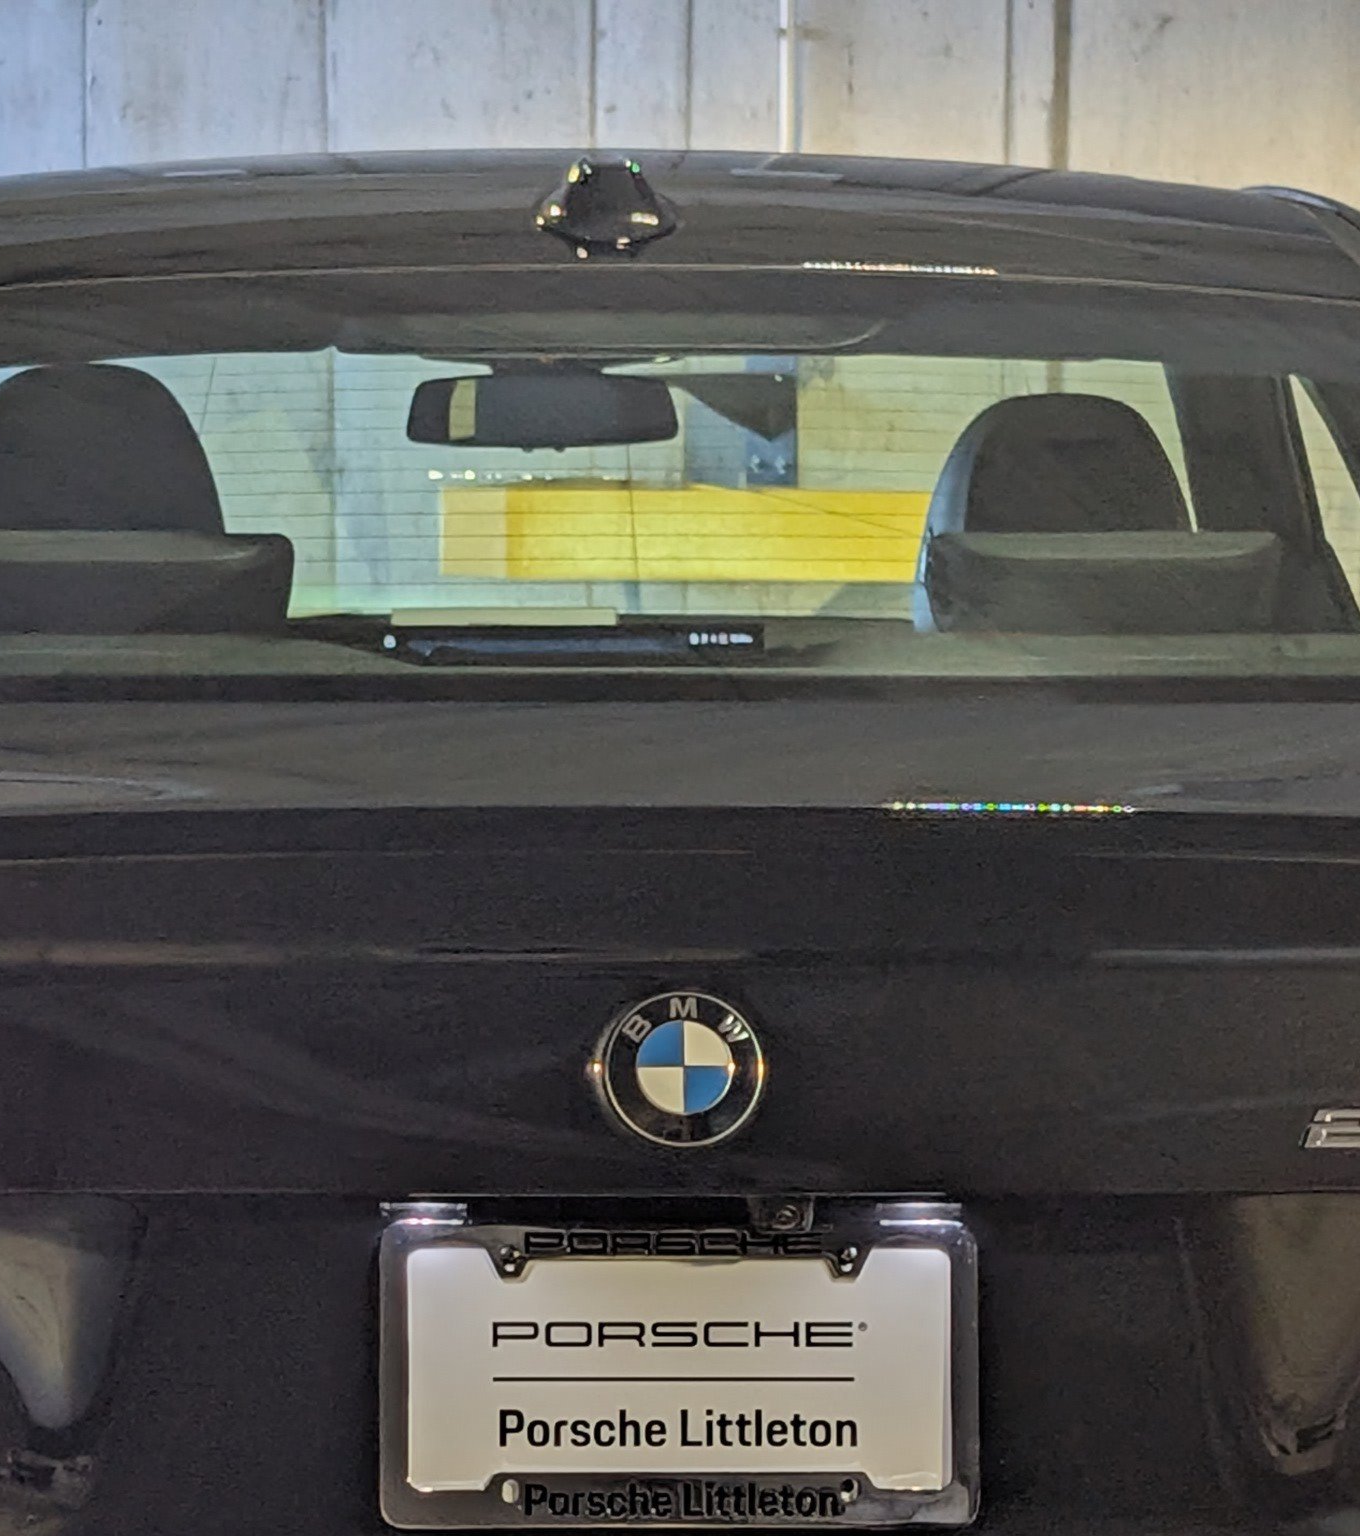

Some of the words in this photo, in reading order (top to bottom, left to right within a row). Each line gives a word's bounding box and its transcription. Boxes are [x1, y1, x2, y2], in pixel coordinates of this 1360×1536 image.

[621, 997, 750, 1044] BMW
[524, 1230, 824, 1256] PORSCHE
[498, 1409, 667, 1448] Porsche
[679, 1409, 859, 1448] Littleton
[524, 1481, 672, 1518] Porsche
[682, 1479, 846, 1518] Littleton
